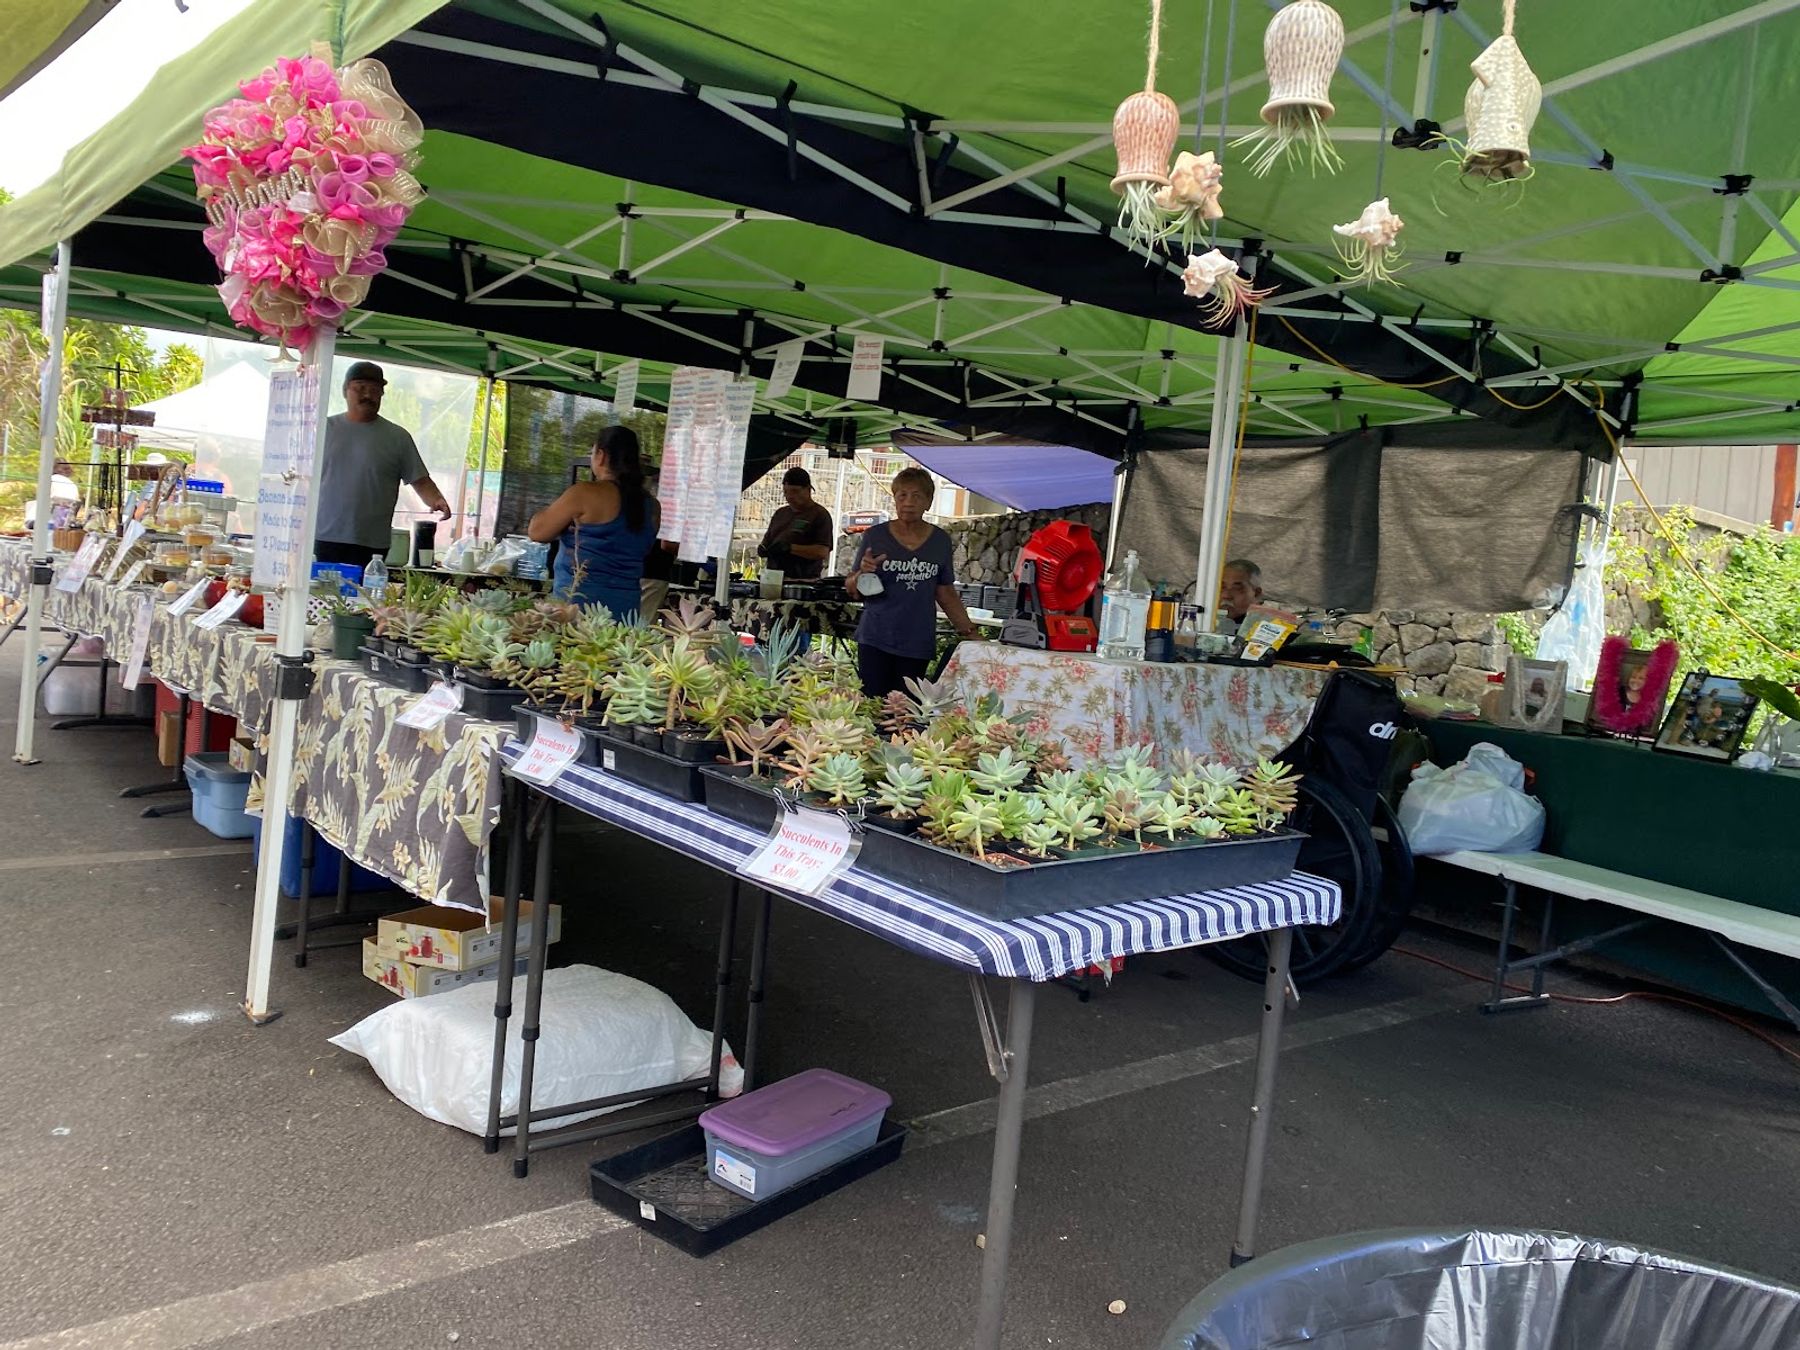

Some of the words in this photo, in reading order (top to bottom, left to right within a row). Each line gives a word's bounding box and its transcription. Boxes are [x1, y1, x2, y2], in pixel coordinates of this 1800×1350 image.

[536, 734, 566, 752] Succulents
[567, 744, 575, 755] In
[779, 824, 829, 850] Succulents
[829, 841, 843, 856] In
[774, 844, 796, 860] This
[796, 852, 824, 869] Tray:
[770, 863, 800, 879] $3.00
